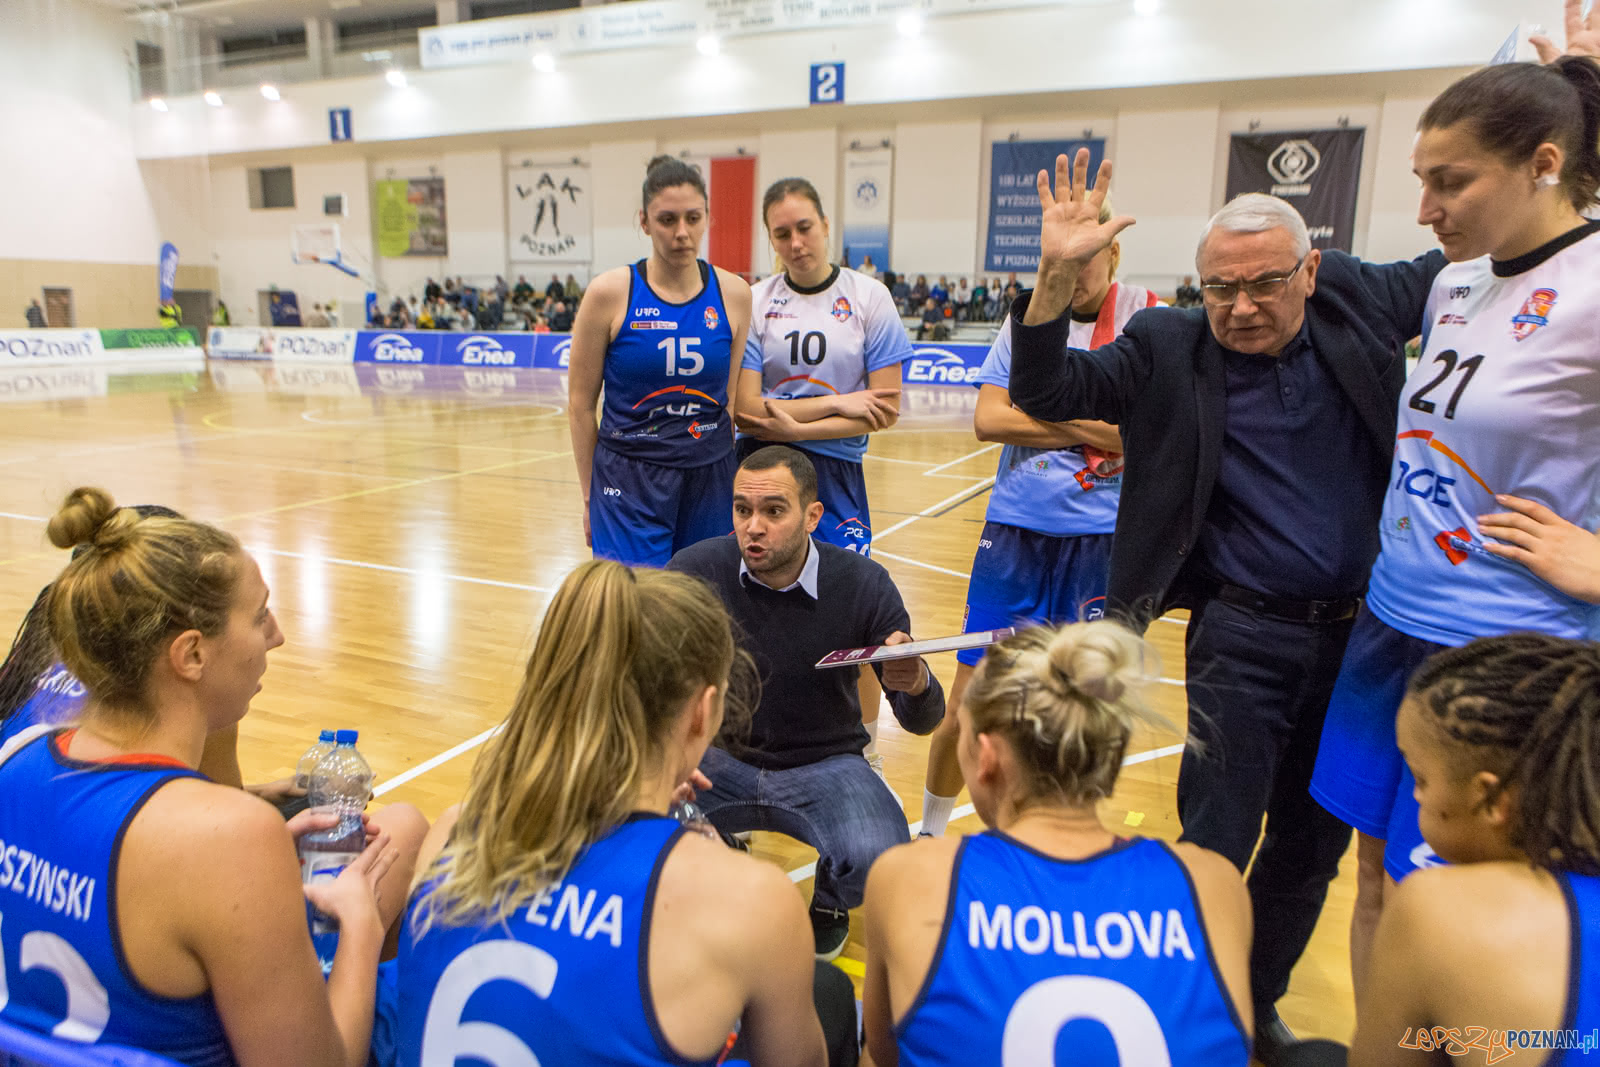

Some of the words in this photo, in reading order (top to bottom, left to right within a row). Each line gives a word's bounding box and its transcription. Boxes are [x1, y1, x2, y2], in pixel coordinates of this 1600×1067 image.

[817, 66, 837, 101] 2
[333, 111, 346, 139] 1
[1016, 174, 1036, 186] LAT
[995, 234, 1041, 246] TECHNICZ
[993, 255, 1003, 265] W
[375, 343, 424, 362] Enea
[462, 345, 516, 365] Enea
[657, 336, 705, 377] 15
[784, 330, 827, 366] 10
[907, 360, 981, 382] Enea
[1408, 349, 1486, 420] 21
[844, 527, 864, 539] PGE
[968, 900, 1196, 961] MOLLOVA
[421, 939, 559, 1067] 6
